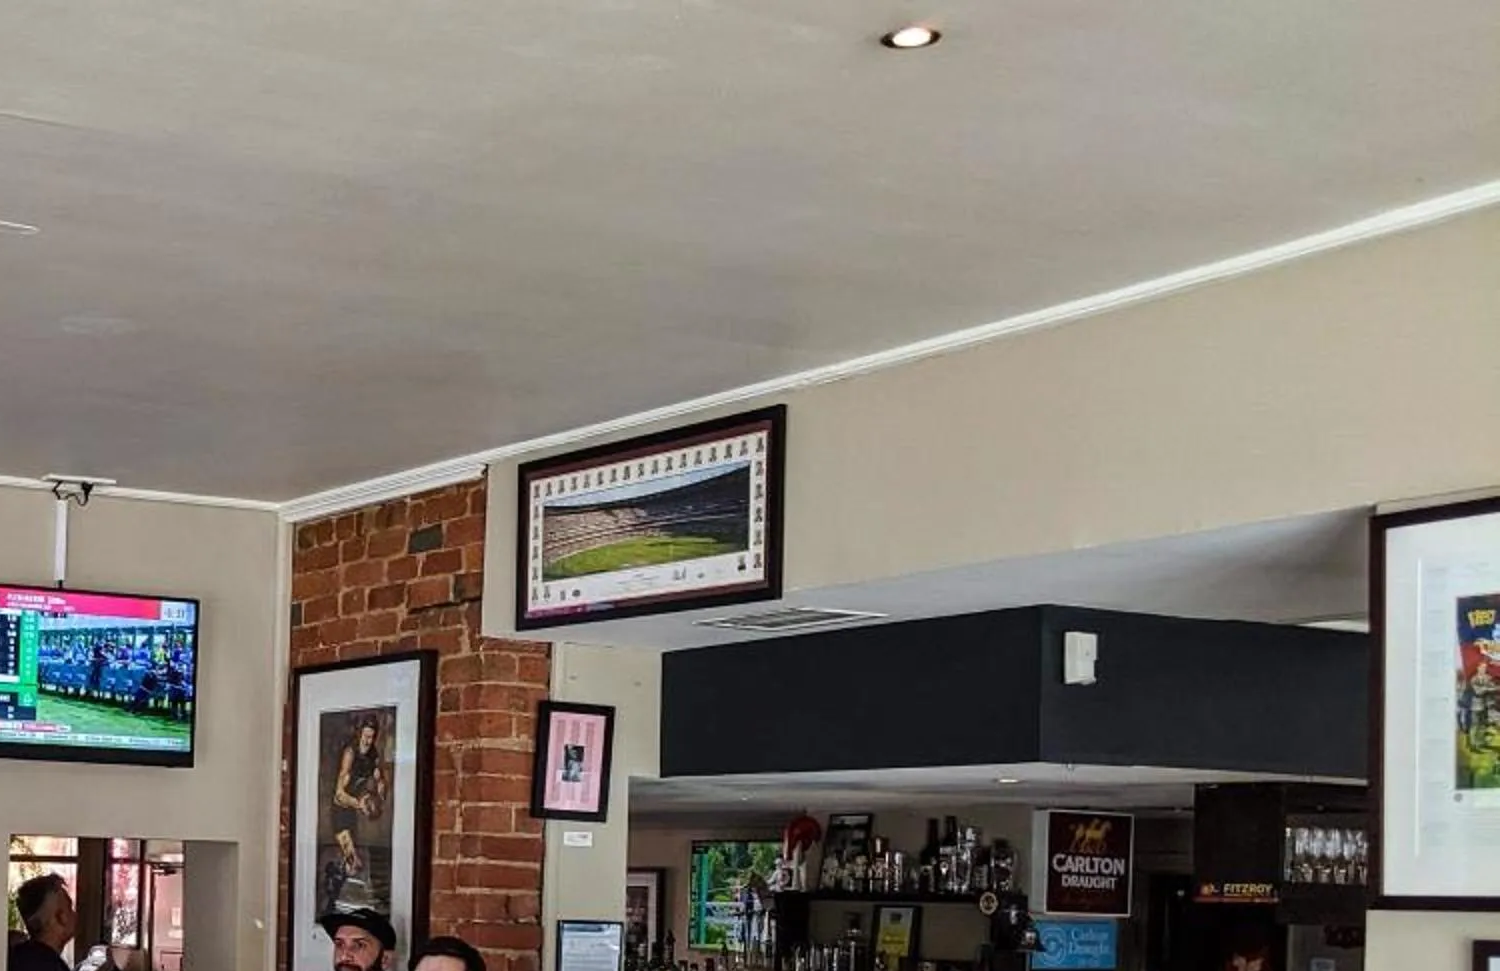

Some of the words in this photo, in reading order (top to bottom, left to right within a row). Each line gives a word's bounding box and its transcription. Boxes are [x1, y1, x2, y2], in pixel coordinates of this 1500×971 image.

[1052, 853, 1125, 876] CARLTON
[1061, 874, 1118, 891] DRAUGHT
[1223, 883, 1273, 895] FITZROY
